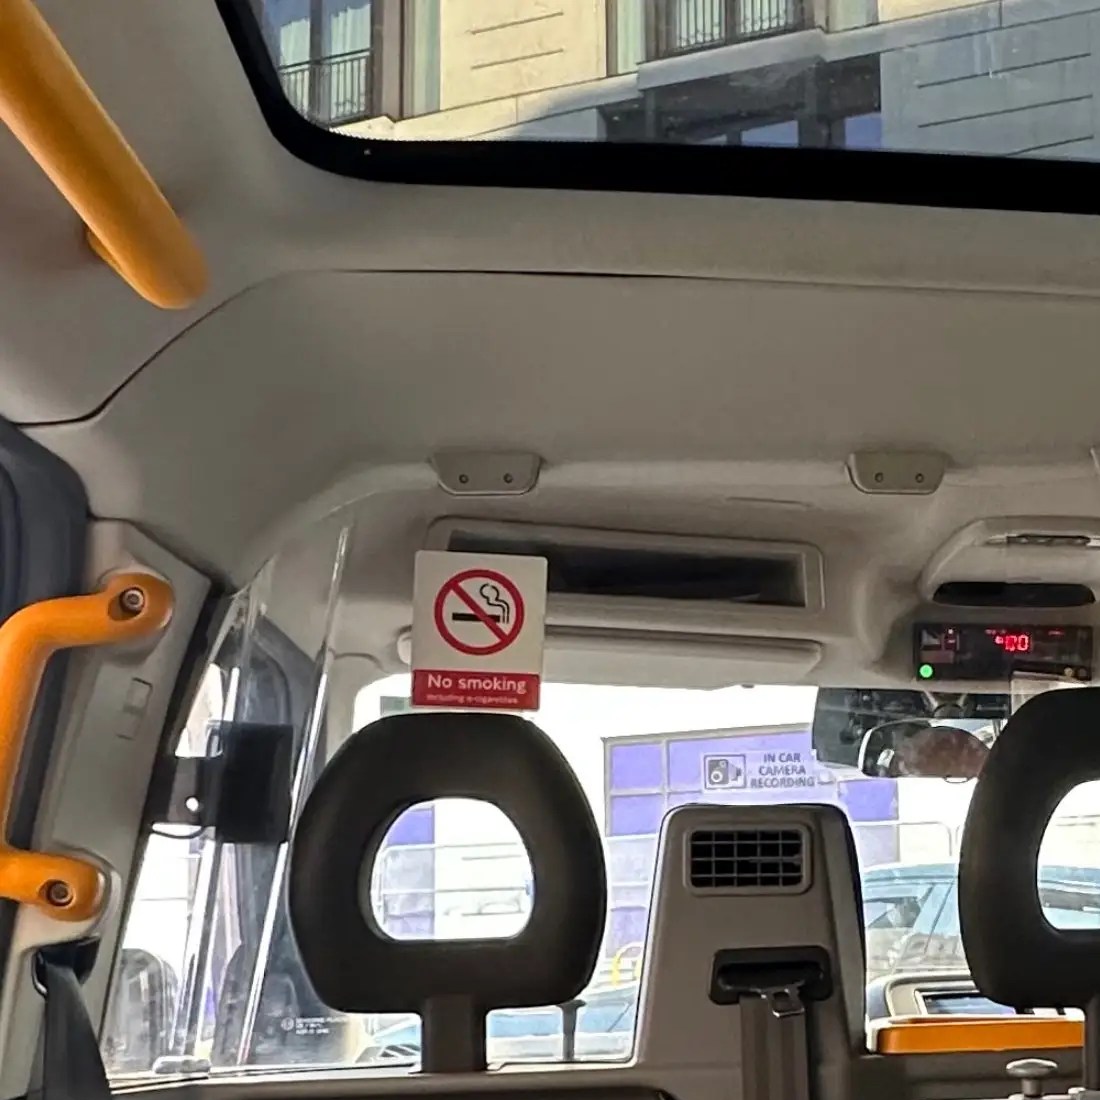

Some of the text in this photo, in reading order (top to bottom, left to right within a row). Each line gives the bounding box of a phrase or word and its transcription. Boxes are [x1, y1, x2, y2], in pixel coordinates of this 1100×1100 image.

[427, 674, 527, 695] No smoking
[763, 752, 801, 763] IN CAR
[758, 765, 806, 776] CAMERA
[750, 777, 815, 789] RECORDING
